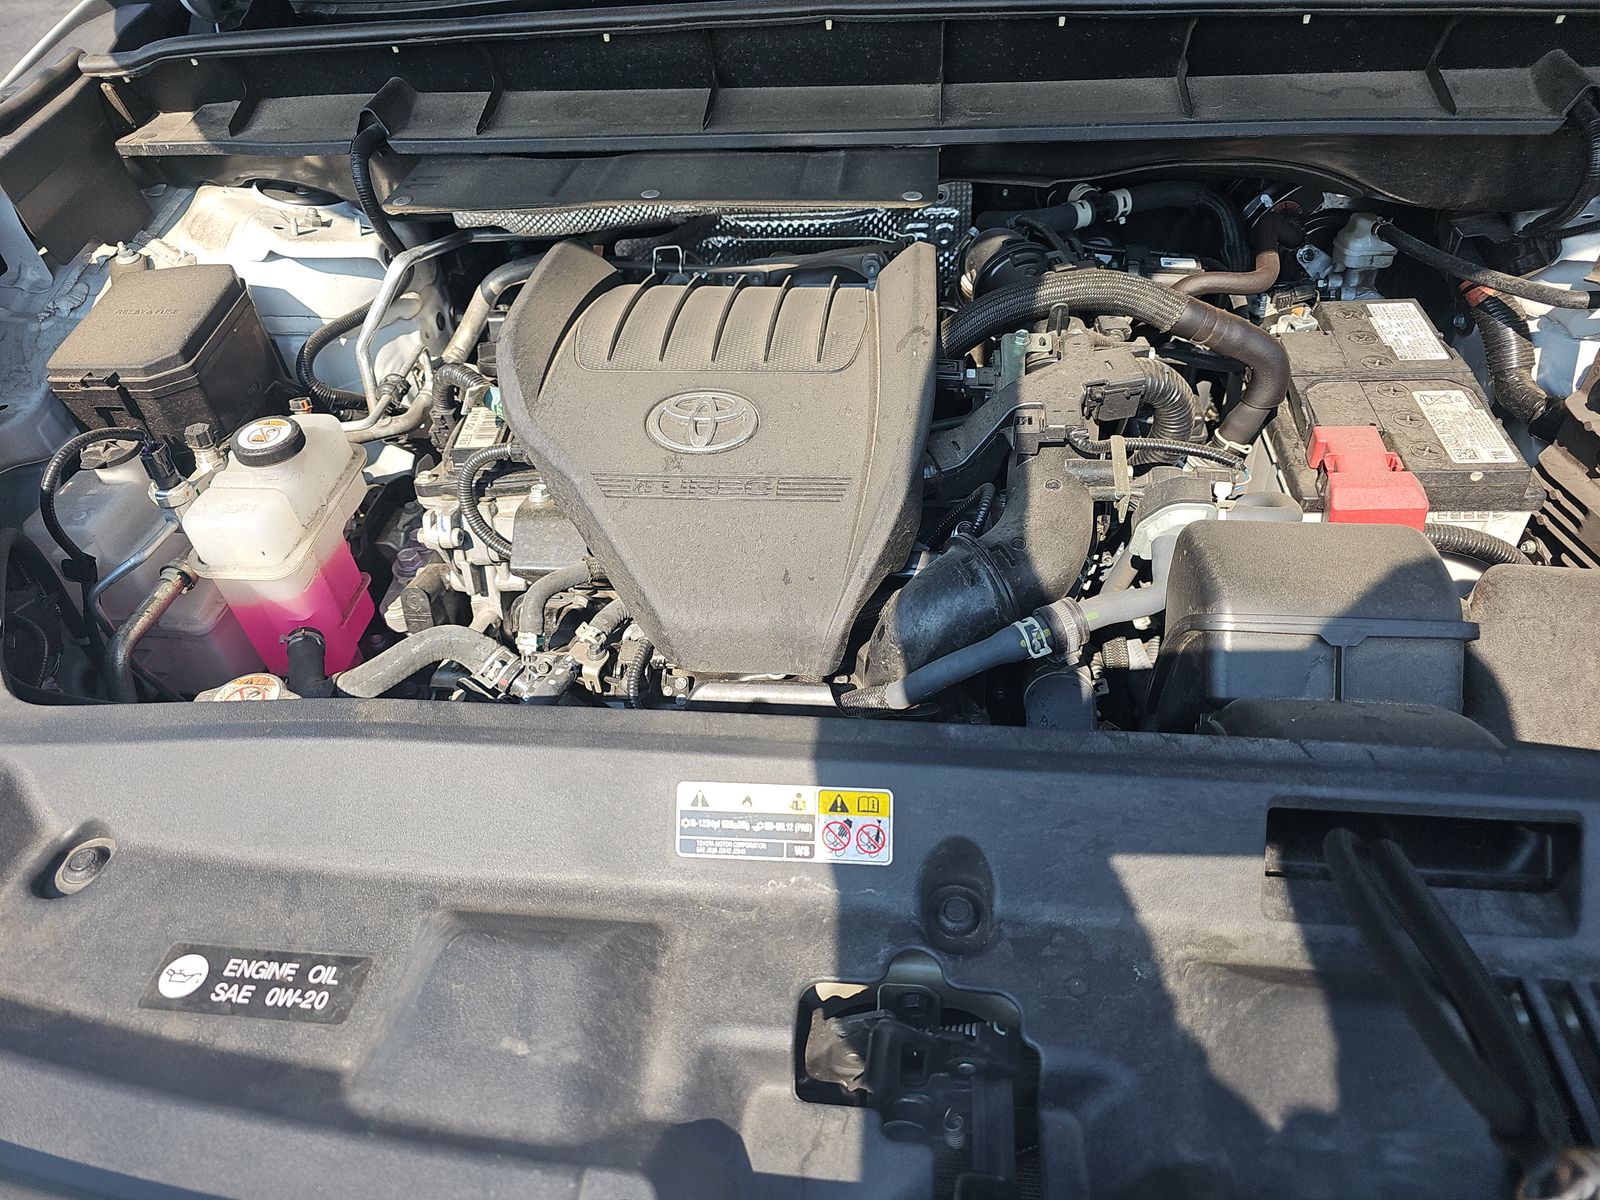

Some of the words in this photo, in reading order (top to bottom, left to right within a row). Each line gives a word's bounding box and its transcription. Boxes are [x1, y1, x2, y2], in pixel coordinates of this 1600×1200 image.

[733, 841, 767, 849] CORPORATION
[222, 958, 300, 982] ENGINE
[307, 964, 339, 986] OIL
[210, 983, 256, 1005] SAE
[264, 987, 329, 1011] 0W-20
